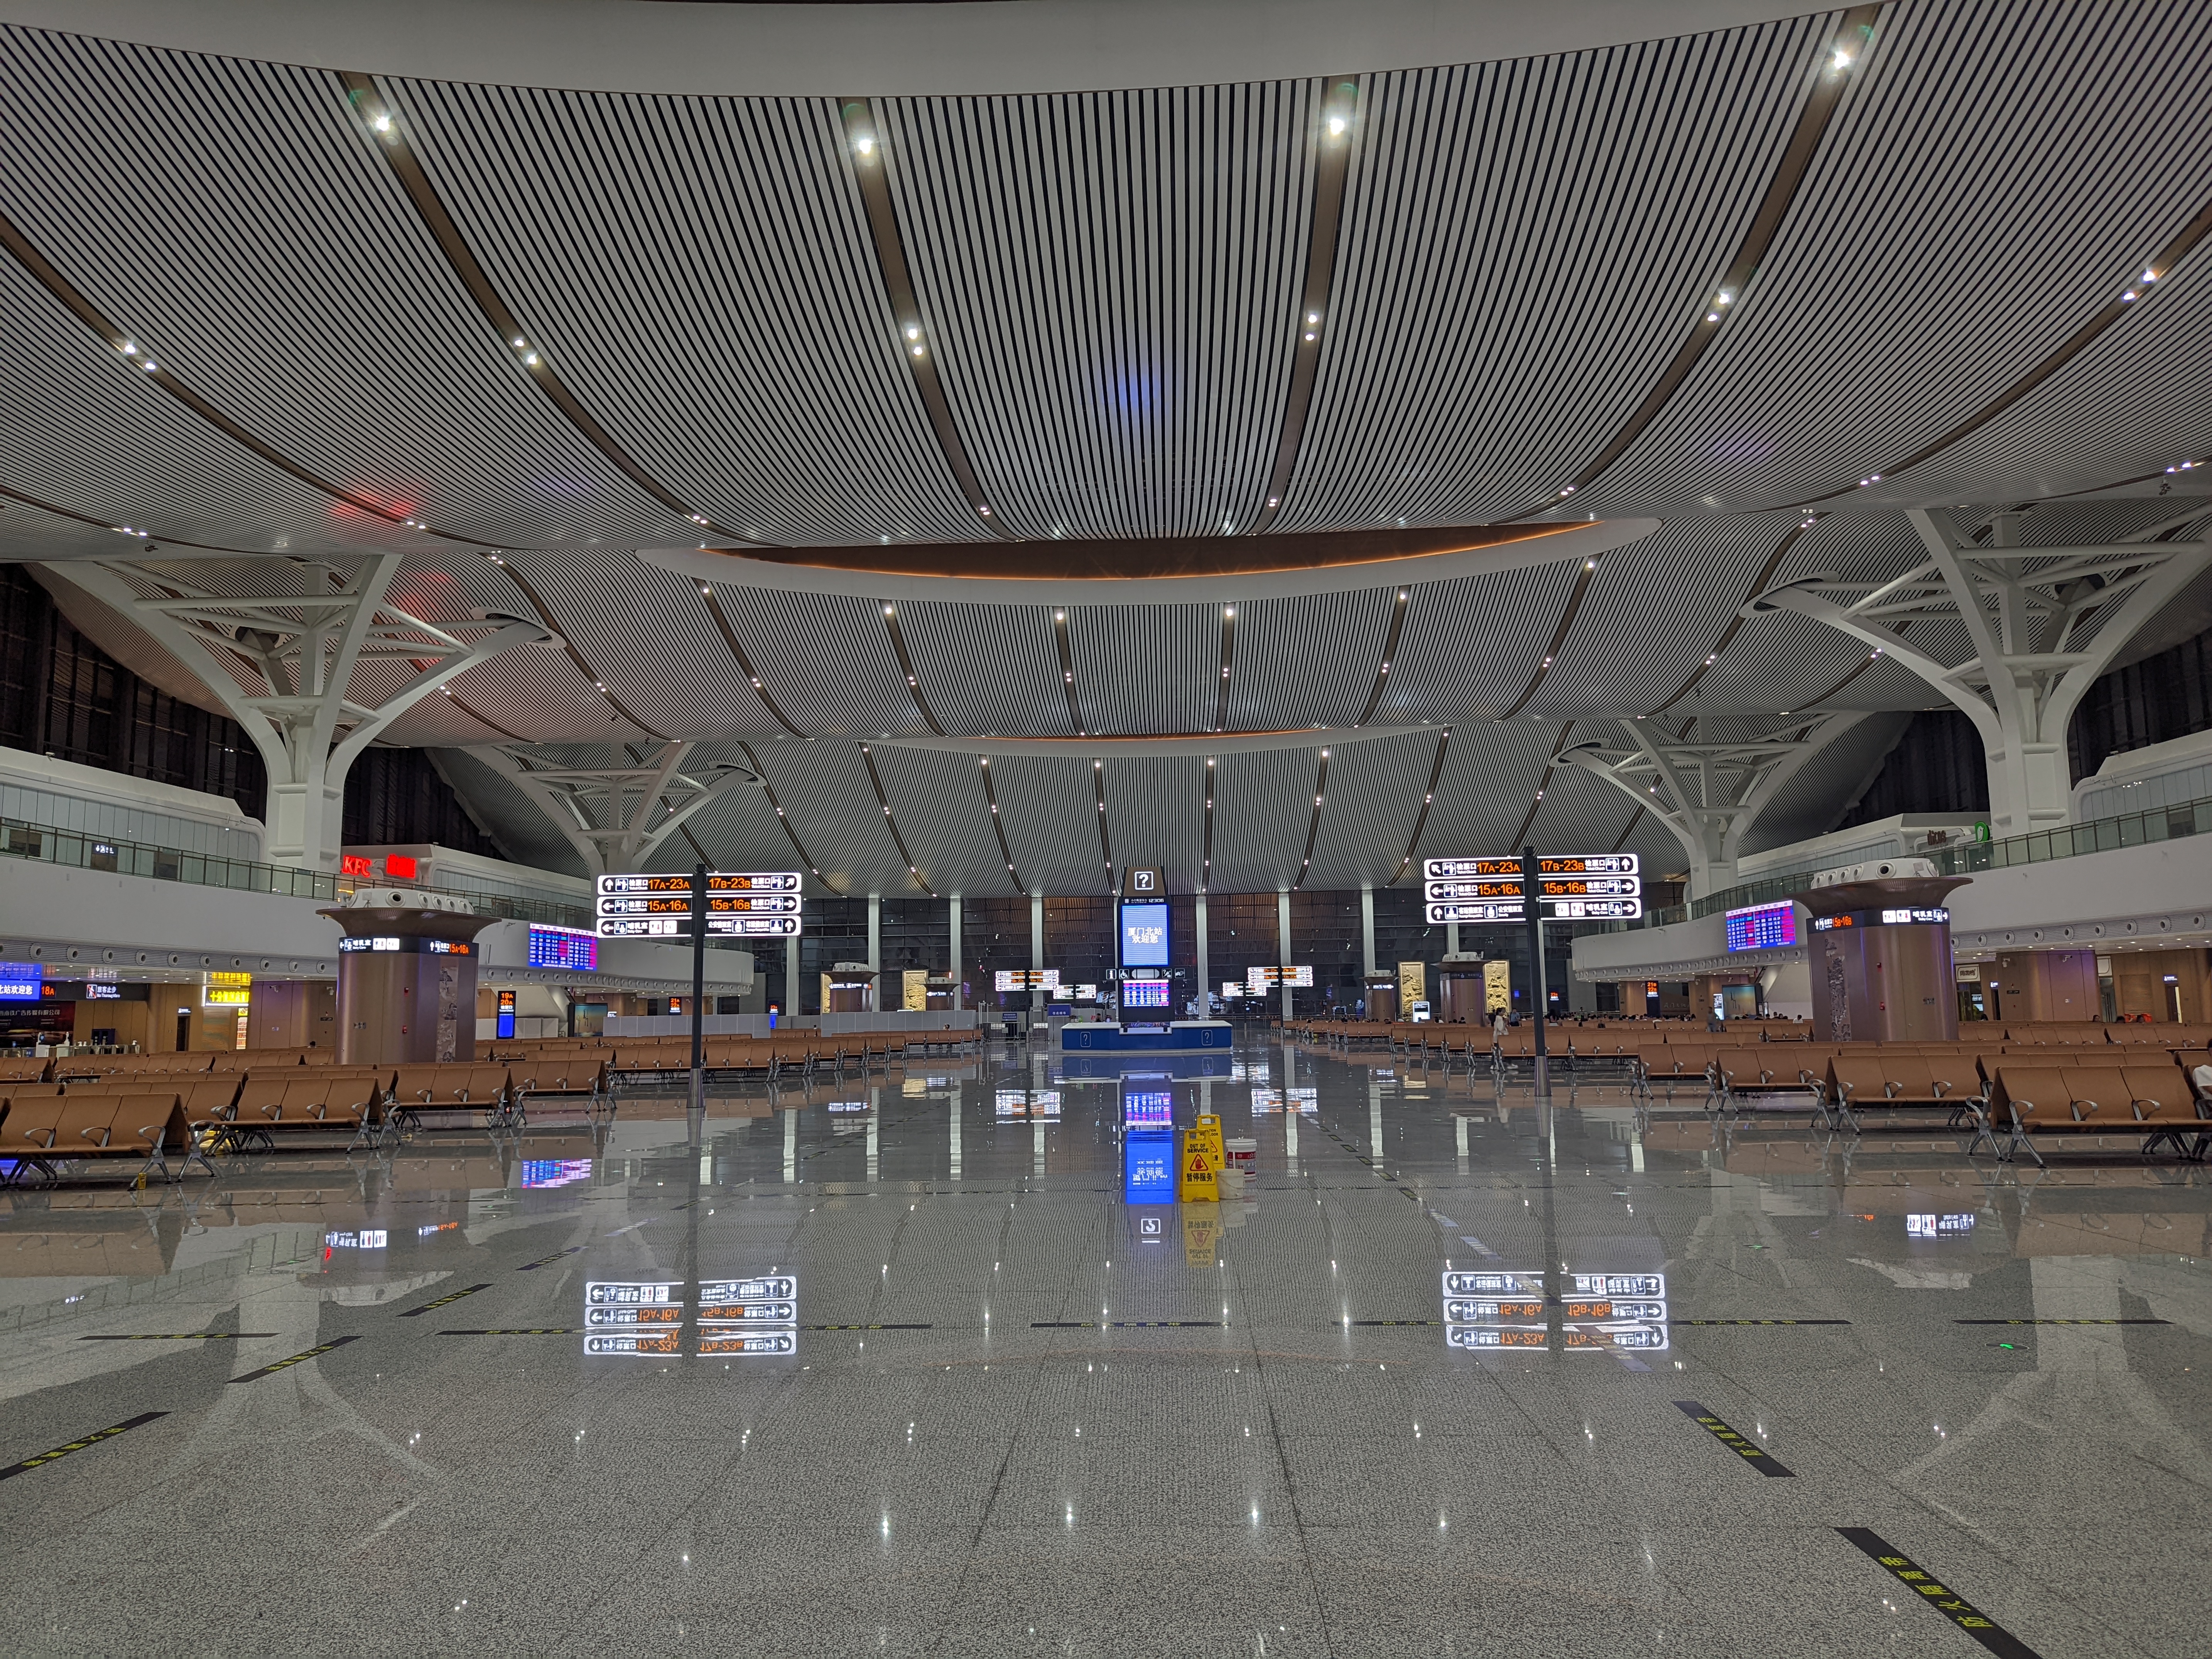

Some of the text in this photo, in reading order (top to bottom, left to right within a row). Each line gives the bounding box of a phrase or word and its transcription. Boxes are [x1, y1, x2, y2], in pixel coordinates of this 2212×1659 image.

[343, 856, 371, 877] KFC
[1477, 862, 1520, 873] 17A-23A
[1540, 860, 1584, 871] 17B-23B
[648, 878, 690, 889] 17A-23A
[709, 878, 750, 888] 17B-23B
[1128, 927, 1163, 936] 厦门北站
[1132, 935, 1158, 944] 欢迎您
[41, 986, 54, 995] 18A
[1186, 1173, 1213, 1182] 暂停服务
